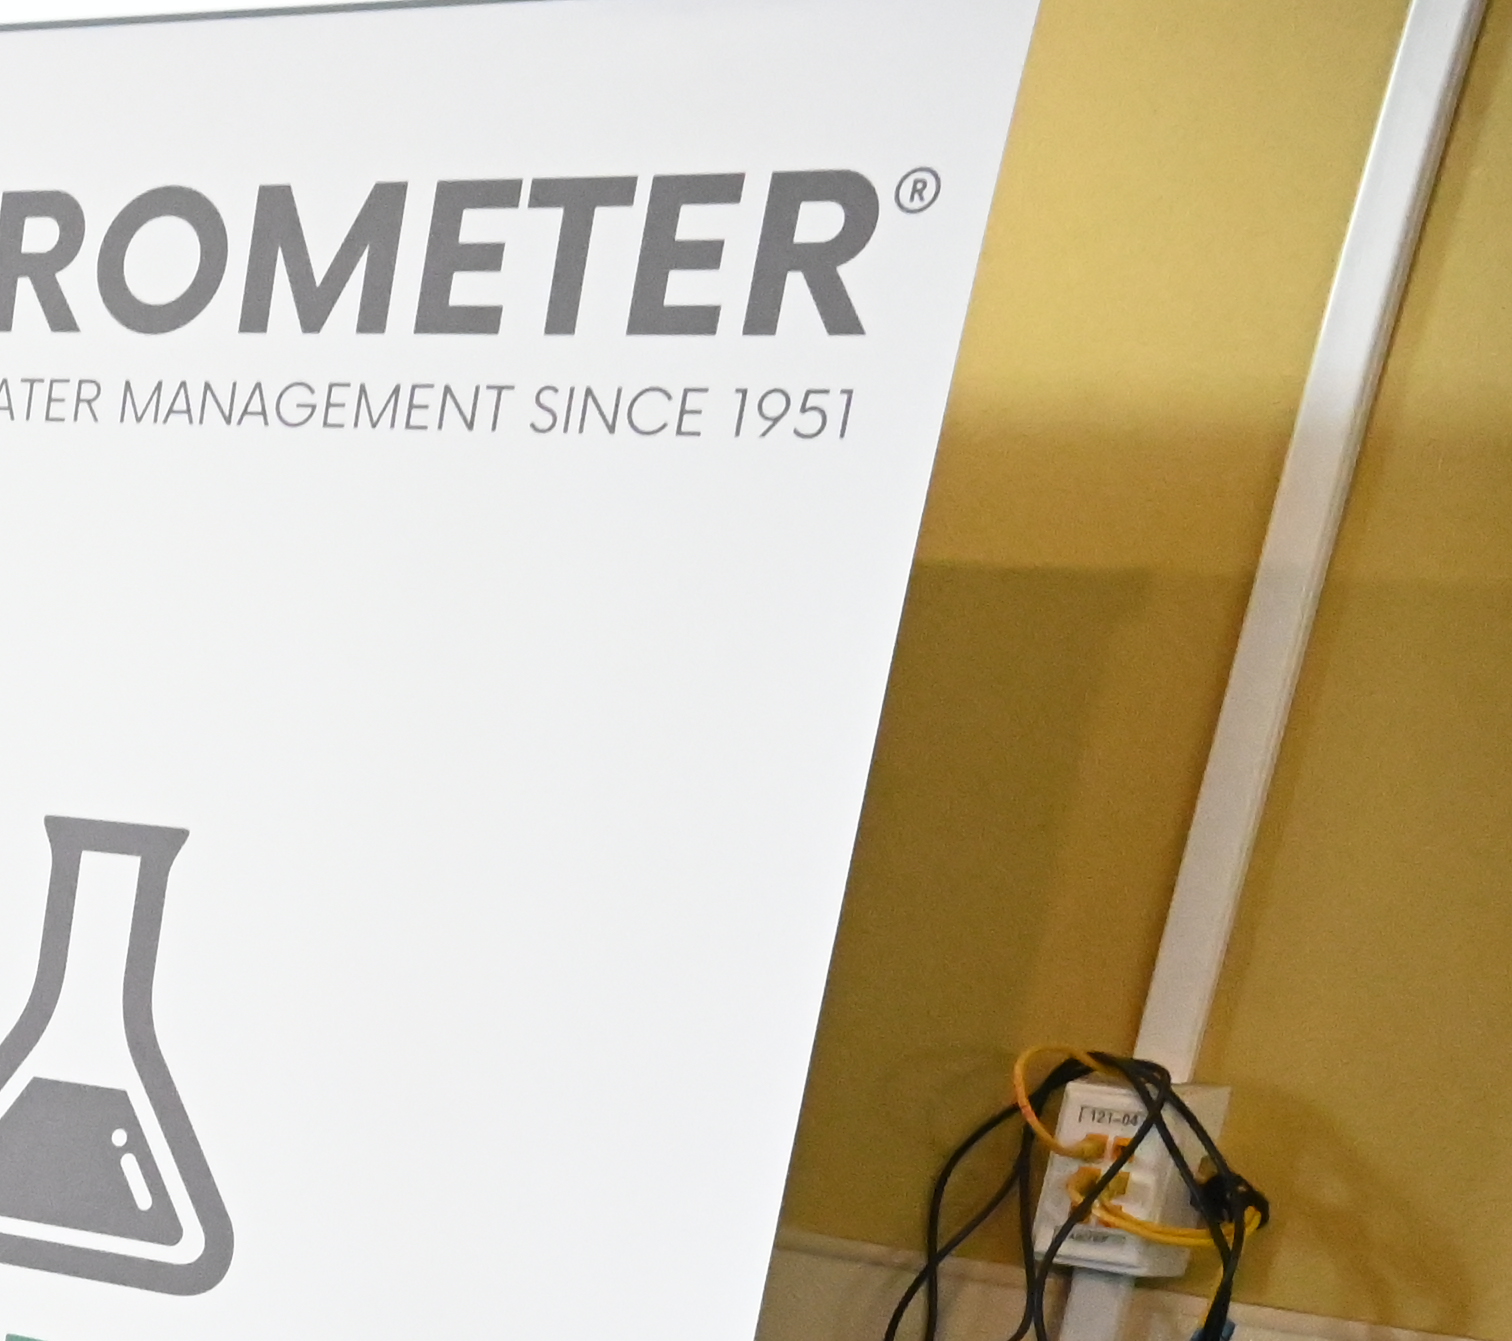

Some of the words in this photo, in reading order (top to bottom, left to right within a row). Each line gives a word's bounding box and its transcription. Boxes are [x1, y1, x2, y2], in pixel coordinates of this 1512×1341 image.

[118, 379, 517, 434] MANAGEMENT
[528, 383, 708, 438] SINCE
[730, 386, 856, 441] 1951
